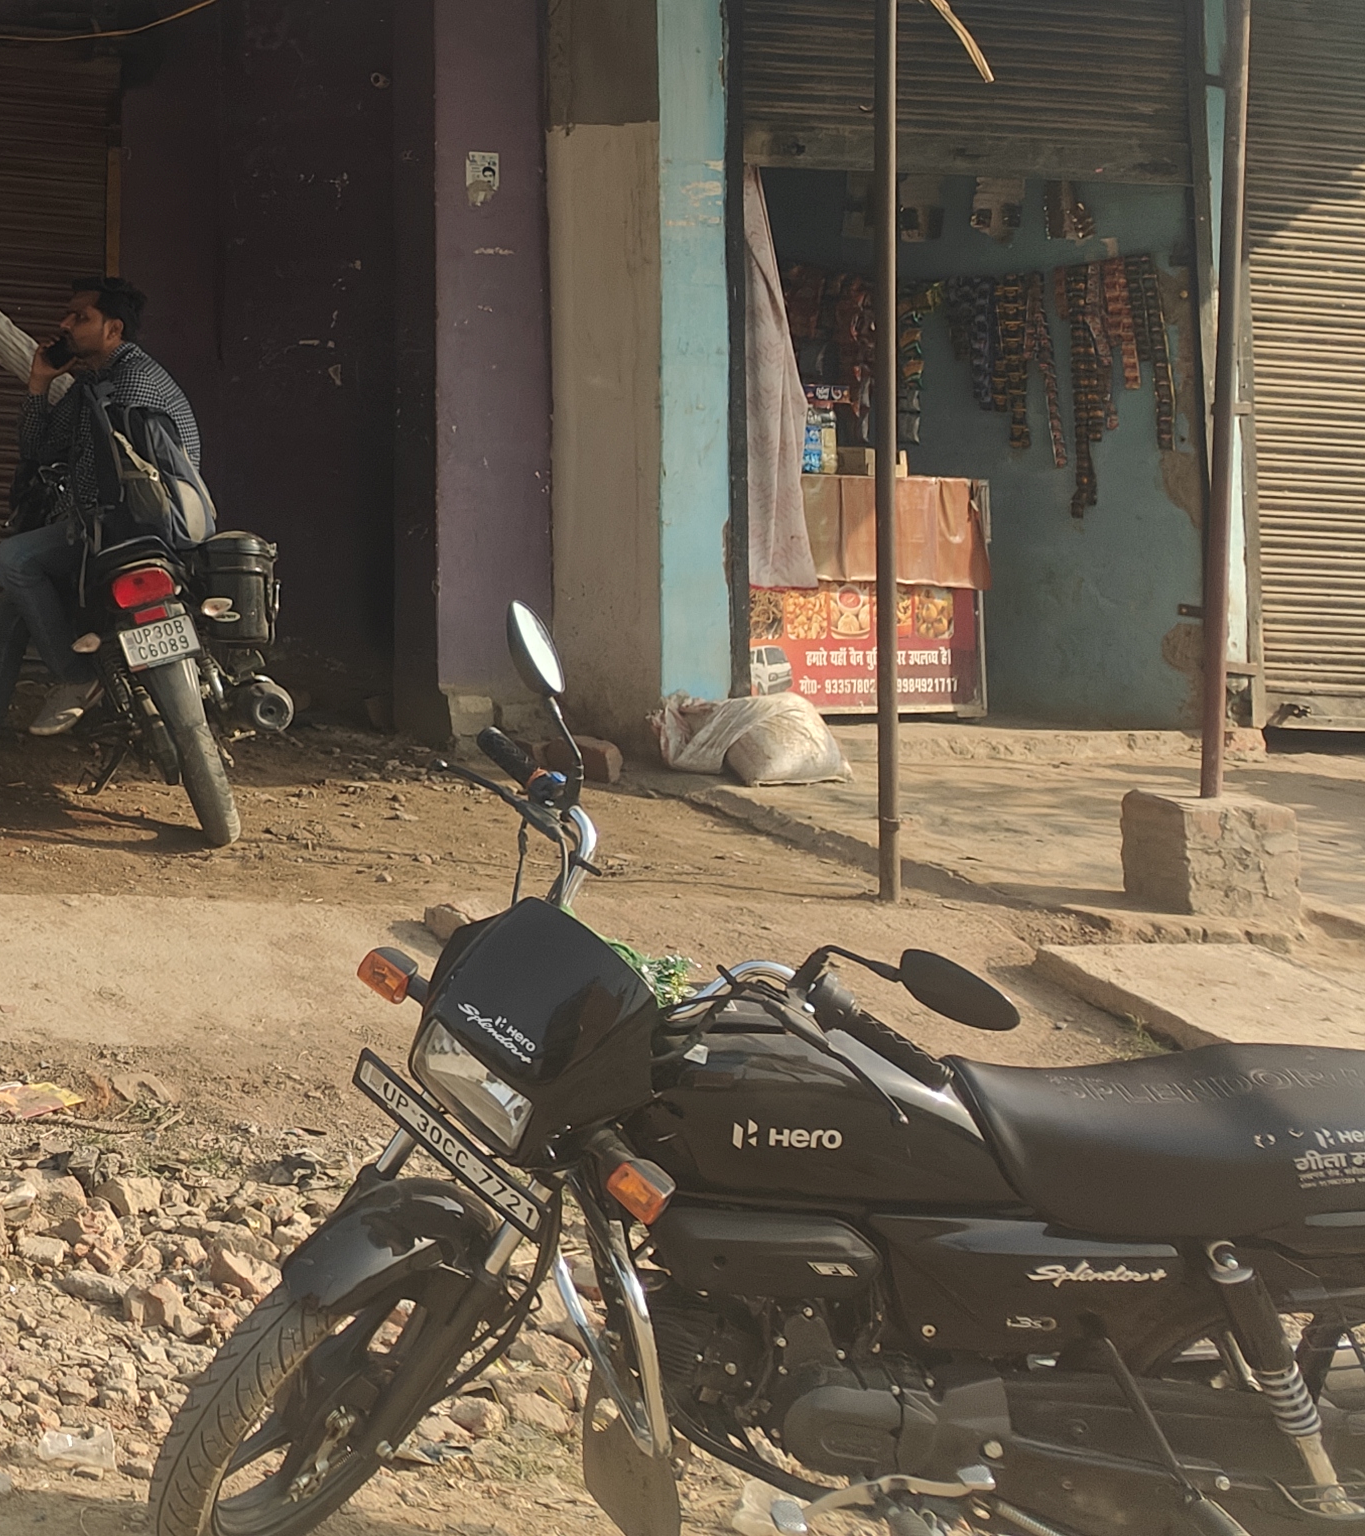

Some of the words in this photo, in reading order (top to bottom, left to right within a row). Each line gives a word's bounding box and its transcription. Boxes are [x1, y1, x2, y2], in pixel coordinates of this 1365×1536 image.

[132, 620, 184, 645] UP30B
[138, 635, 189, 660] C6089
[805, 647, 828, 666] हमारे
[506, 1024, 537, 1053] Hero
[768, 1127, 843, 1150] Hero
[1294, 1150, 1348, 1172] गीता
